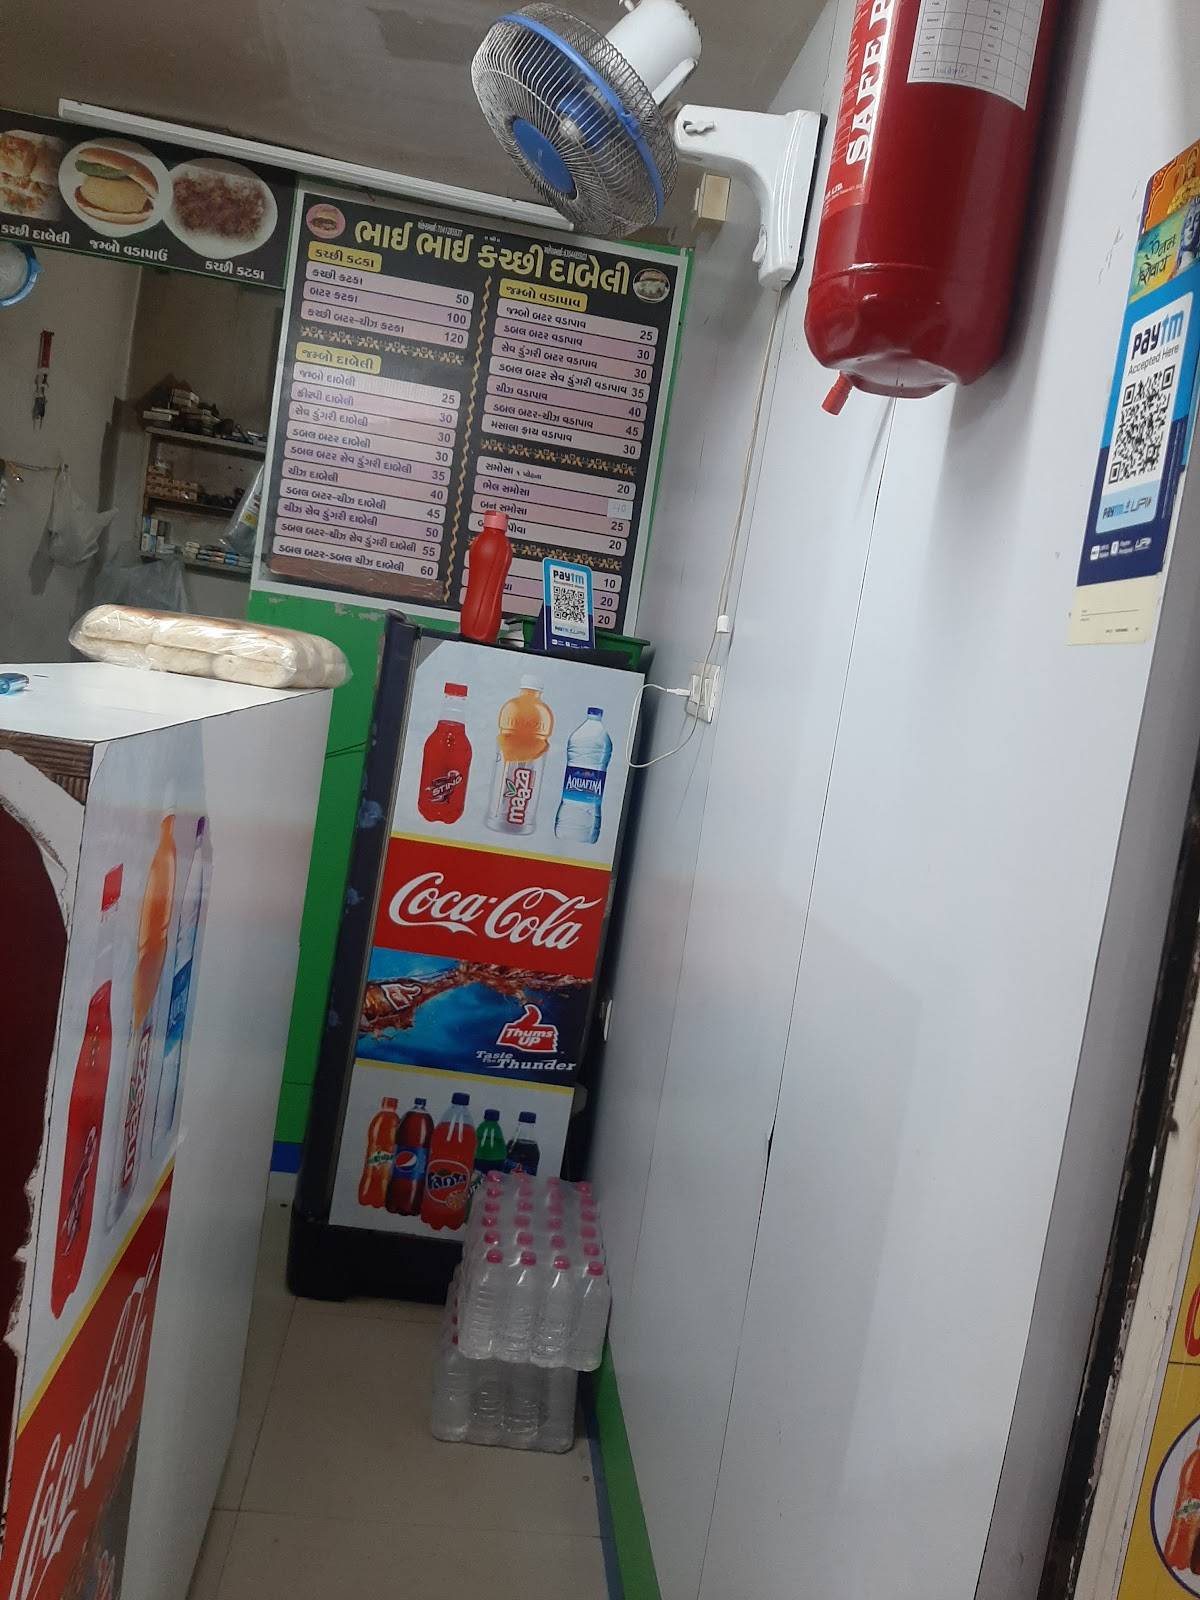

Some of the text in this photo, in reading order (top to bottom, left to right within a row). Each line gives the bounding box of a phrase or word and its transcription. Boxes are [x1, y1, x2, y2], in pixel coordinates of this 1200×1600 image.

[846, 36, 884, 166] SAFE
[33, 230, 70, 245] દાબેલી
[89, 239, 120, 254] જમ્બો
[205, 260, 264, 280] કચ્છી કટકા
[315, 248, 374, 268] કચ્છી કટકા
[355, 220, 413, 251] ભાઈ
[416, 232, 474, 263] ભાઈ
[478, 243, 544, 279] કચ્છી
[549, 255, 630, 295] દાબેલી
[312, 269, 469, 305] કચ્છી કટકા 50
[506, 285, 581, 308] જમ્બો વડાપાવ
[309, 287, 466, 325] બટર કટકા 100
[307, 307, 331, 320] કચ્છી
[380, 322, 404, 334] કટકા
[444, 332, 464, 345] 120
[507, 306, 653, 341] જમ્બો બટર વડાપાવ 25
[302, 348, 373, 370] જમ્બો દાબેલી
[504, 325, 650, 360] ડબલ બટર વડાપાવ 30
[501, 342, 516, 354] સેવ
[543, 352, 564, 364] બટર
[566, 356, 598, 369] વડાપાવ
[634, 369, 647, 380] 30
[1128, 343, 1180, 376] Accepted Here
[327, 375, 356, 387] દાબેલી
[441, 394, 455, 405] 25
[499, 363, 522, 375] ડબલ
[525, 368, 547, 380] બટર
[549, 370, 565, 383] સેવ
[594, 380, 627, 394] વડાપાવ
[631, 387, 645, 399] 35
[325, 394, 354, 407] દાબેલી
[439, 413, 452, 424] 30
[496, 382, 641, 417] ચીઝ વડાપાવ 40
[295, 405, 310, 417] સેવ
[339, 415, 368, 427] દાબેલી
[437, 432, 450, 443] 30
[493, 403, 515, 414] ડબલ
[563, 416, 593, 429] વડાપાવ
[625, 425, 639, 436] 45
[292, 426, 448, 462] ડબલ બટર દાબેલી 30
[491, 420, 519, 433] મસાલા
[541, 430, 572, 443] વડાપાવ
[623, 444, 636, 455] 30
[290, 446, 313, 457] ડબલ
[316, 450, 337, 462] બટર
[340, 452, 355, 464] સેવ
[384, 461, 412, 474] દાબેલી
[432, 470, 445, 481] 35
[485, 462, 514, 475] સમોસા
[617, 484, 630, 495] 20
[288, 465, 443, 501] ચીઝ દાબેલી 40
[482, 479, 499, 491] ભેલ
[501, 484, 530, 497] સમોસા
[286, 486, 309, 497] ડબલ
[358, 496, 386, 510] દાબેલી
[427, 509, 441, 519] 45
[499, 502, 527, 516] સમોસા
[611, 521, 624, 532] 25
[283, 502, 302, 515] ચીઝ
[305, 506, 320, 518] સેવ
[349, 514, 378, 527] દાબેલી
[425, 527, 439, 538] 50
[281, 523, 303, 534] ડબલ
[349, 531, 363, 544] સેવ
[390, 539, 416, 553] દાબેલી
[422, 546, 436, 557] 55
[609, 540, 622, 551] 20
[278, 544, 302, 555] ડબલ
[355, 553, 373, 567] ચીઝ
[376, 558, 404, 572] દાબેલી
[420, 565, 434, 576] 60
[604, 578, 616, 589] 10
[600, 596, 613, 607] 20
[598, 615, 610, 625] 20
[508, 768, 531, 825] maaza
[566, 774, 603, 795] AQUAFINA
[389, 871, 602, 950] Coca-Cola
[505, 1028, 553, 1038] Thums
[476, 1050, 513, 1059] Taste
[497, 1059, 576, 1071] Thunder
